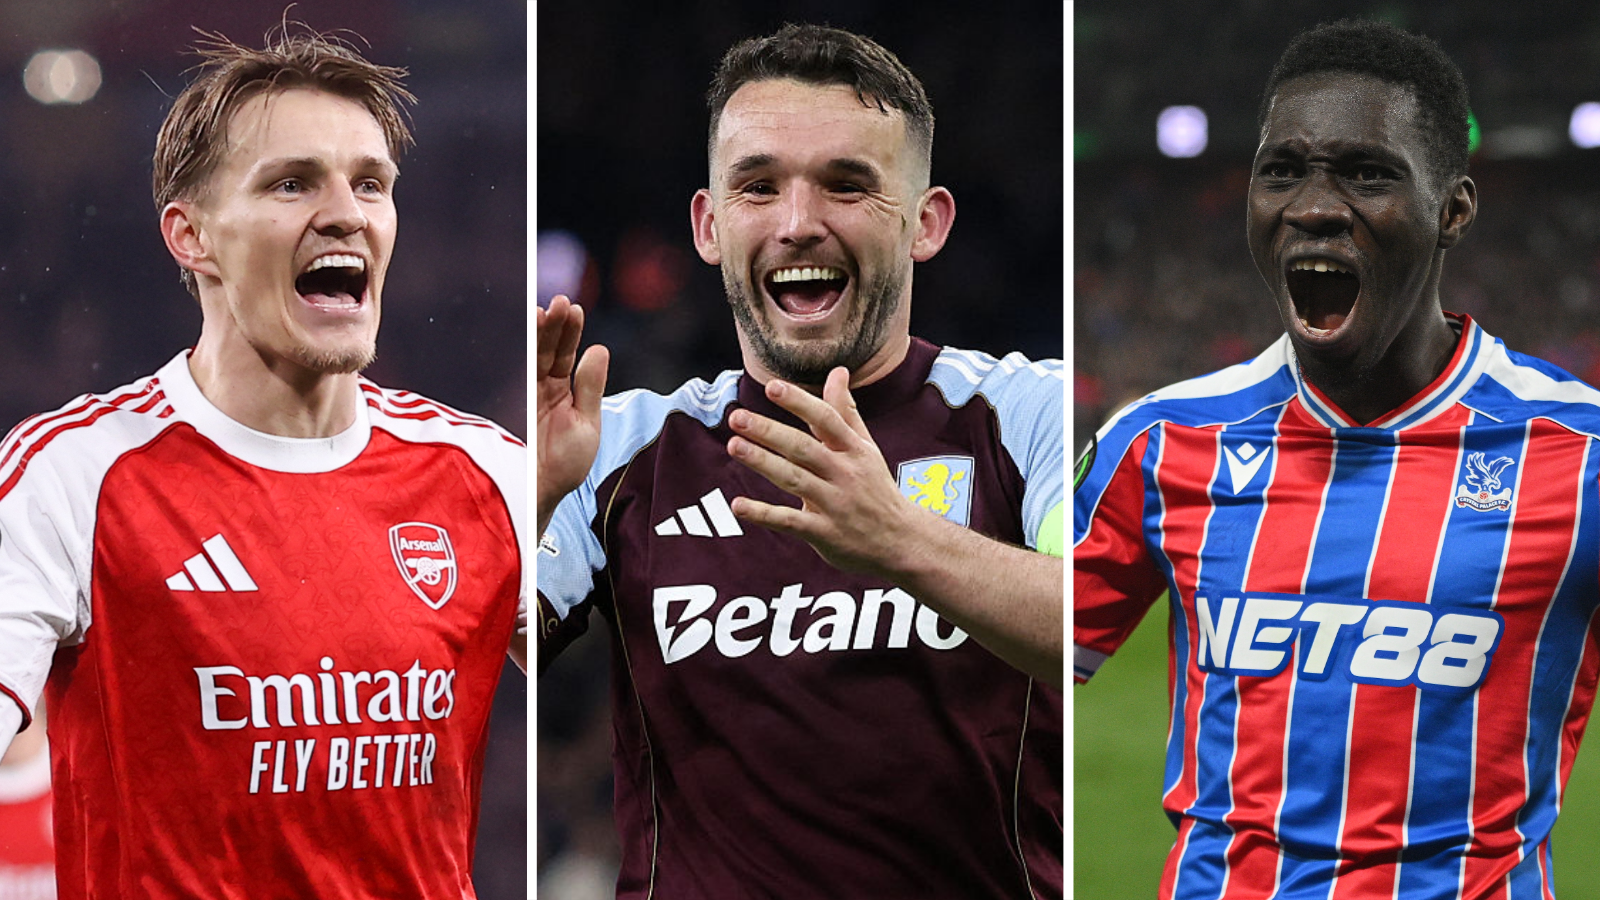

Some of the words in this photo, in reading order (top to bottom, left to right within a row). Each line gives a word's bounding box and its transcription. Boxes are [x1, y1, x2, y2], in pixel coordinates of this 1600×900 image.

[1459, 497, 1480, 508] CRYSTAL
[1479, 501, 1498, 509] PALACE
[400, 537, 444, 552] Arsenal
[652, 584, 969, 664] Betano
[1195, 596, 1500, 688] NET88
[193, 656, 455, 730] Emirates
[249, 739, 316, 794] FLY
[327, 733, 436, 791] BETTER
